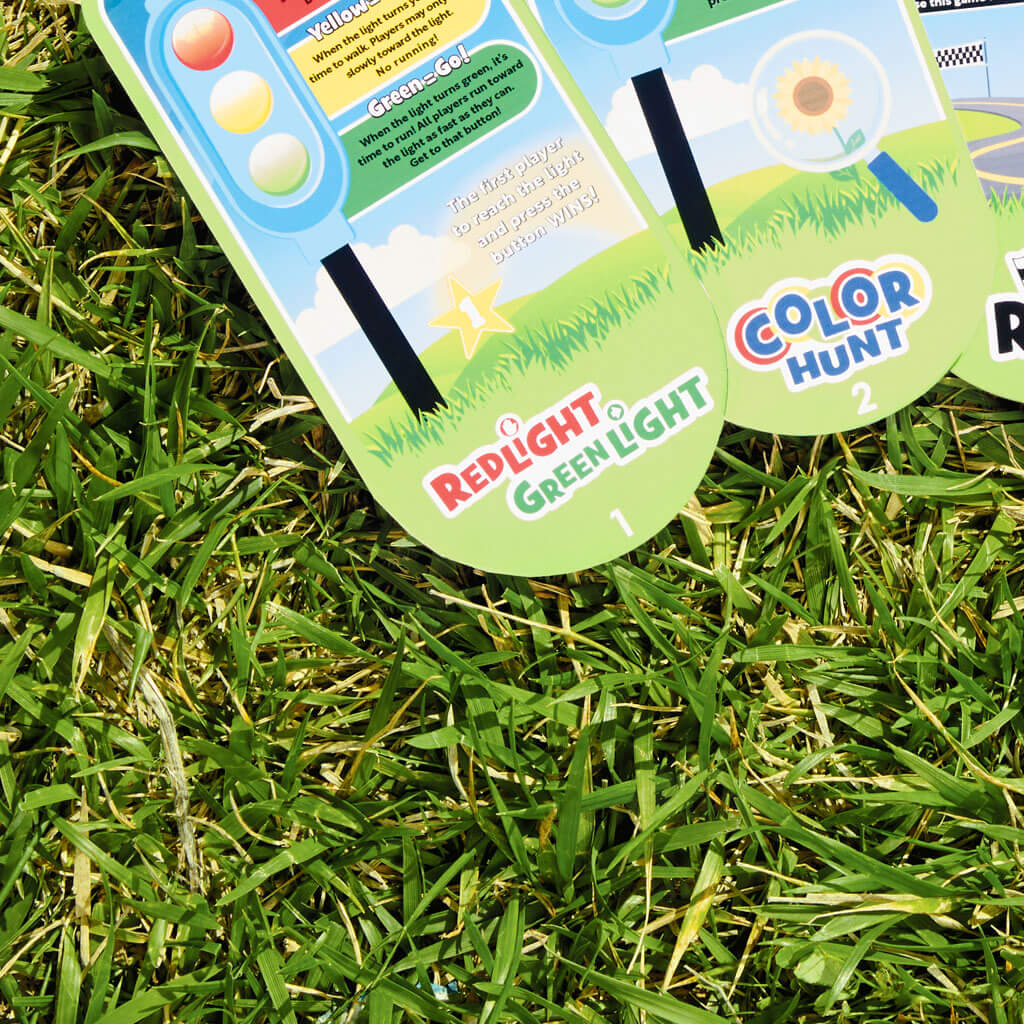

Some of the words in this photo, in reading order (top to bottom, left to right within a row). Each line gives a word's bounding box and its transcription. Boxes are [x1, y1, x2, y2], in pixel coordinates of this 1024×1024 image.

[309, 67, 333, 83] time
[332, 60, 344, 69] to
[344, 45, 370, 62] walk.
[369, 22, 405, 46] Players
[405, 9, 425, 25] may
[312, 44, 343, 63] When
[342, 33, 360, 45] the
[359, 18, 383, 35] light
[383, 2, 409, 21] turns
[346, 56, 376, 78] slowly
[377, 33, 412, 58] toward
[411, 25, 429, 37] the
[428, 10, 451, 27] light.
[376, 65, 392, 77] No
[394, 33, 439, 66] running!
[358, 149, 382, 166] time
[382, 141, 394, 151] to
[395, 126, 416, 144] run!
[417, 116, 432, 131] All
[432, 95, 469, 123] players
[469, 84, 487, 98] run
[487, 59, 524, 86] toward
[359, 127, 391, 147] When
[390, 116, 409, 128] the
[408, 99, 433, 118] light
[433, 83, 461, 102] turns
[461, 65, 493, 88] green,
[382, 155, 401, 168] the
[400, 139, 425, 157] light
[426, 132, 438, 142] as
[437, 118, 458, 135] fast
[458, 111, 470, 122] as
[470, 96, 493, 114] they
[494, 86, 515, 99] can.
[410, 152, 429, 167] Get
[429, 146, 441, 156] to
[442, 131, 464, 148] that
[463, 106, 501, 135] button!
[446, 190, 480, 214] The
[479, 167, 515, 195] first
[515, 136, 565, 176] player
[451, 223, 471, 238] to
[472, 192, 518, 226] reach
[516, 175, 546, 198] the
[543, 150, 585, 180] light
[477, 220, 509, 249] and
[510, 197, 553, 231] press
[552, 178, 582, 201] the
[489, 225, 548, 265] button
[546, 185, 601, 229] WINS!
[745, 269, 920, 354] COLOR
[785, 317, 902, 385] HUNT
[852, 381, 879, 416] 2
[608, 507, 635, 537] 1
